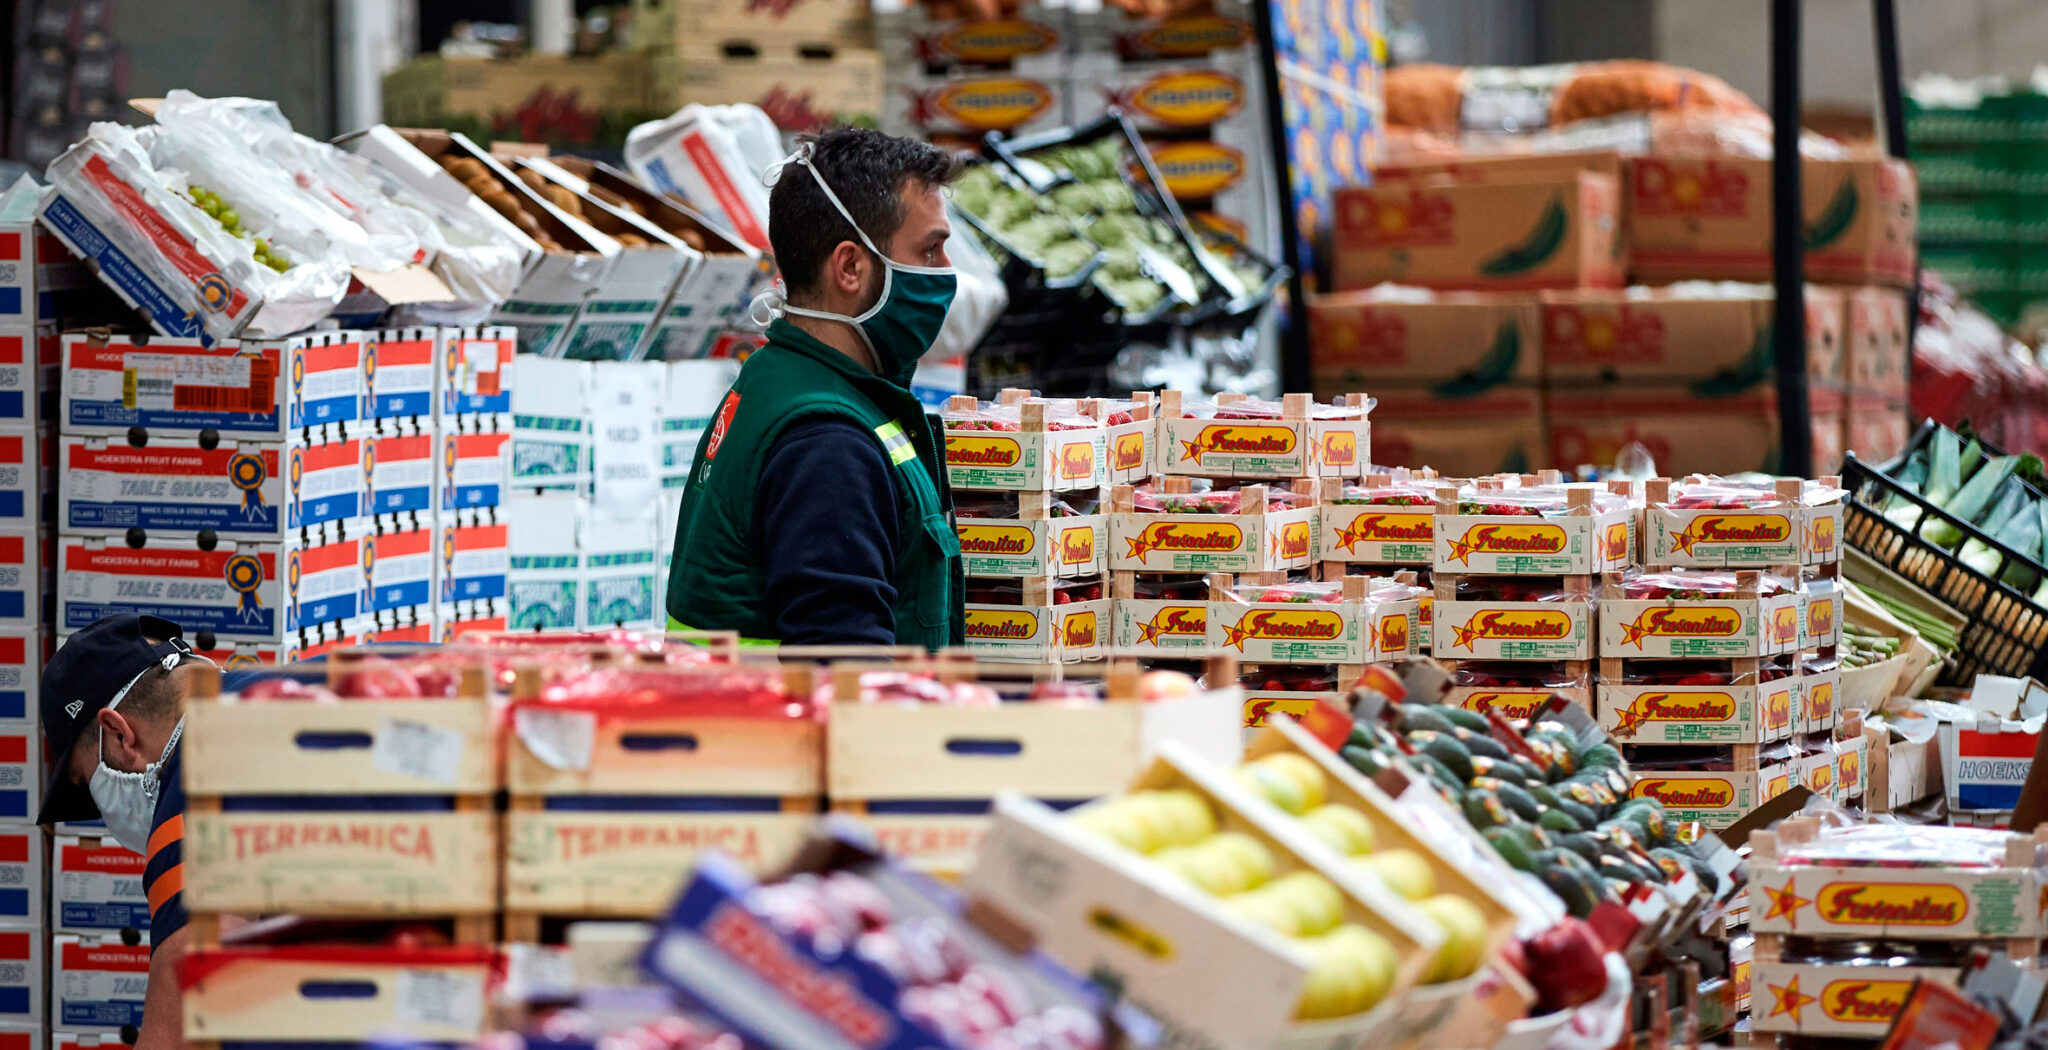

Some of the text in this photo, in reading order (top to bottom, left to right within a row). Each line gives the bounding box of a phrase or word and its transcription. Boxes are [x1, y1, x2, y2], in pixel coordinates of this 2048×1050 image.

[1208, 429, 1288, 452] Fresonitas
[95, 456, 202, 466] HOEKSTRA FRUIT FARMS
[120, 479, 230, 498] TABLE GRAPES
[1152, 524, 1235, 549] Fresonitas
[1361, 515, 1433, 539] Fresonita
[1475, 527, 1559, 550] Fresonitas
[1699, 518, 1783, 540] Fresonitas
[92, 556, 200, 568] HOEKSTRA FRUIT FARMS
[116, 580, 227, 600] TABLE GRAPES
[1164, 610, 1206, 632] Freso
[1250, 612, 1335, 637] Fresonitas
[1479, 612, 1563, 636] Fresonitas
[1648, 609, 1734, 634] Fresonitas
[1642, 694, 1728, 719] Fresonitas
[1958, 760, 2033, 780] HOEKS
[1643, 781, 1726, 805] Fresonitas
[232, 823, 436, 863] TERRAMICA
[87, 855, 134, 865] HOEKSTRA
[1828, 886, 1957, 922] Fresonitas
[88, 953, 135, 963] HOEKSTRA
[1833, 984, 1901, 1017] Freso
